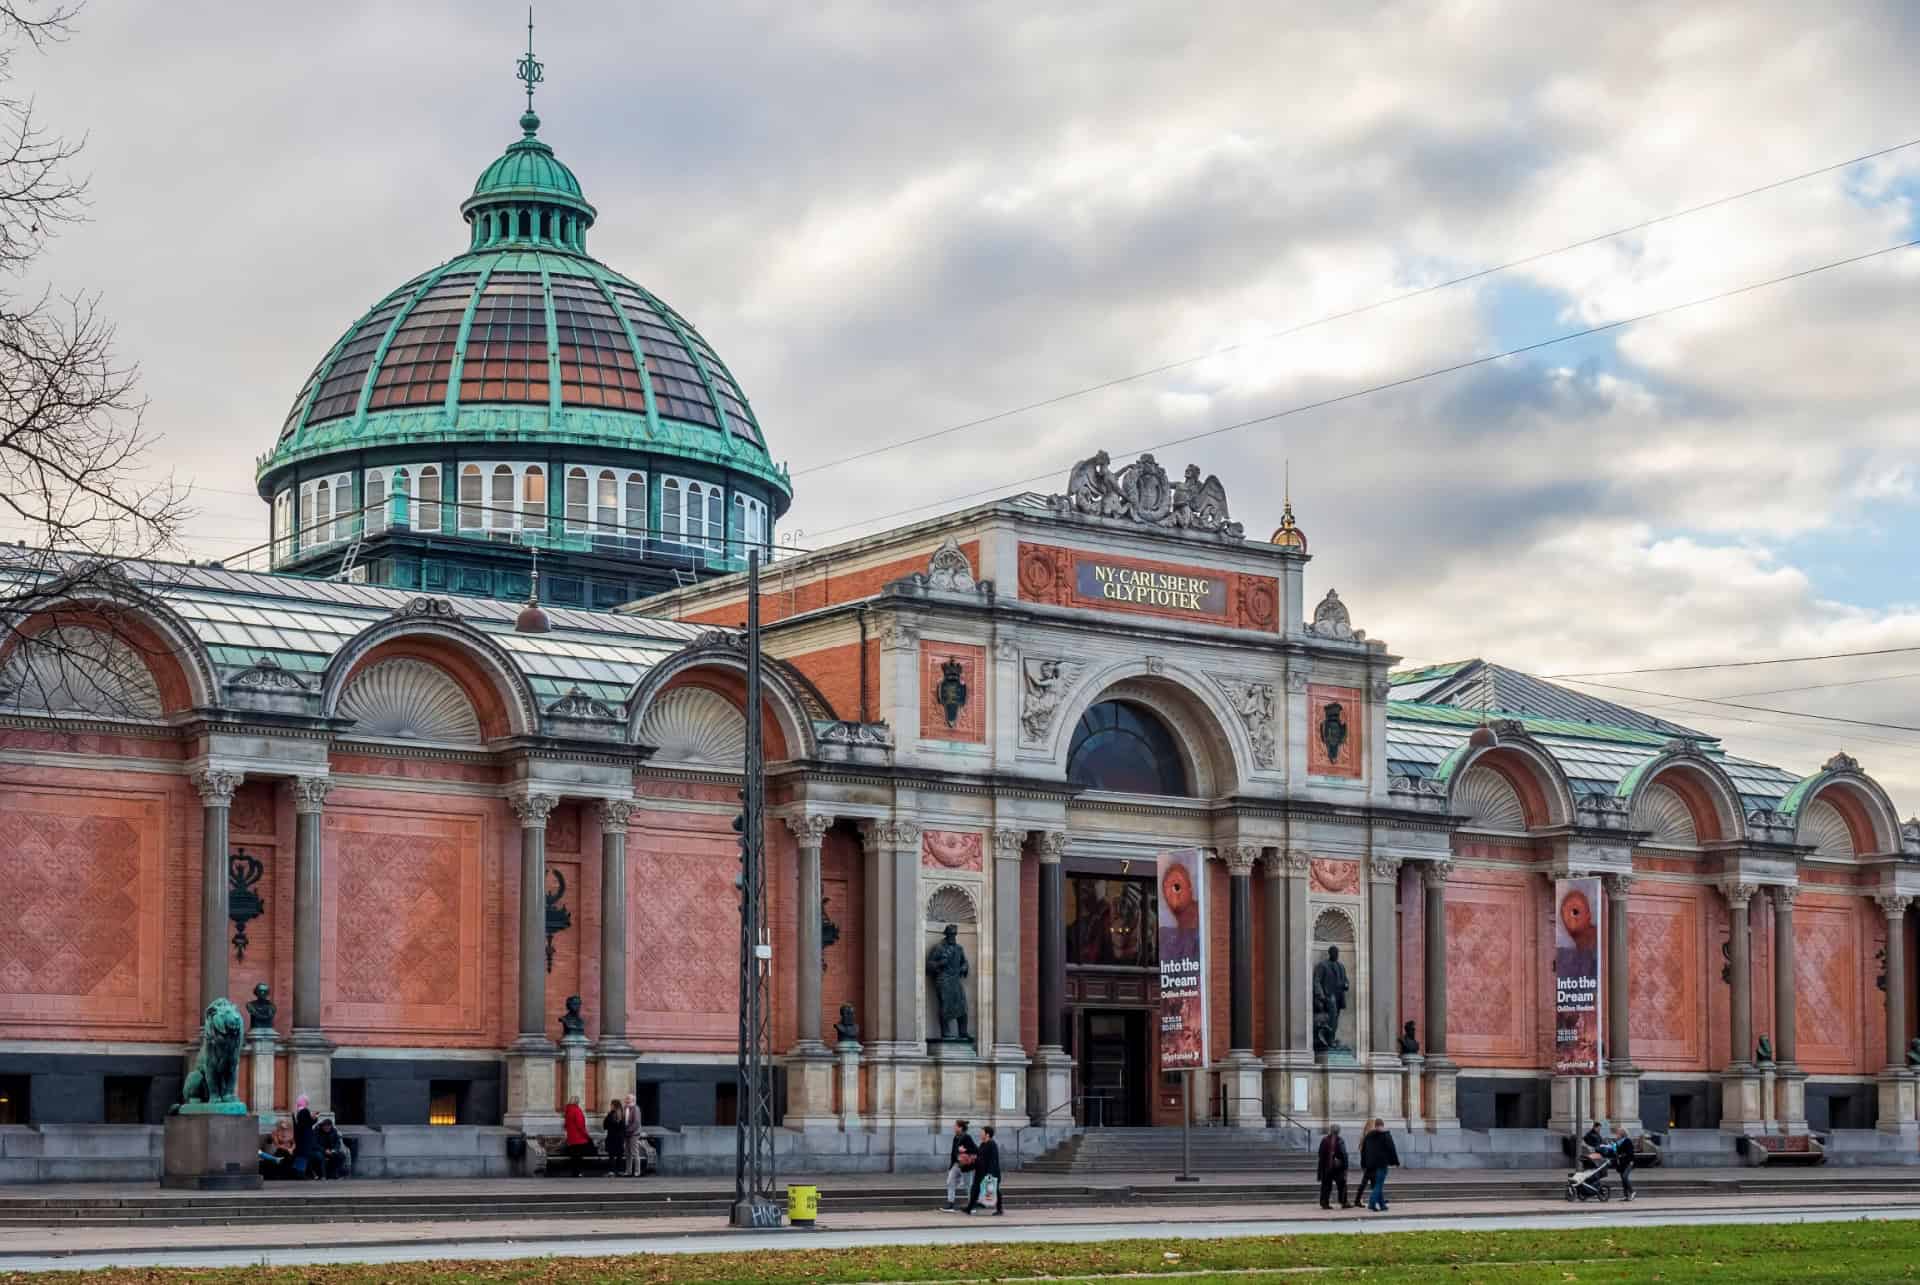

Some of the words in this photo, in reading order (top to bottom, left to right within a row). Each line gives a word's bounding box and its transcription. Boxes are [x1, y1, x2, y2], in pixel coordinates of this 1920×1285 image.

[1095, 565, 1209, 595] NY-CARLSBERG
[1103, 582, 1201, 610] GLYPTOTEK
[1120, 859, 1130, 873] 7
[1160, 959, 1181, 973] Into
[1182, 957, 1199, 972] the
[1160, 974, 1197, 988] Dream
[1557, 976, 1578, 990] Into
[1579, 975, 1596, 989] the
[1557, 990, 1594, 1003] Dream
